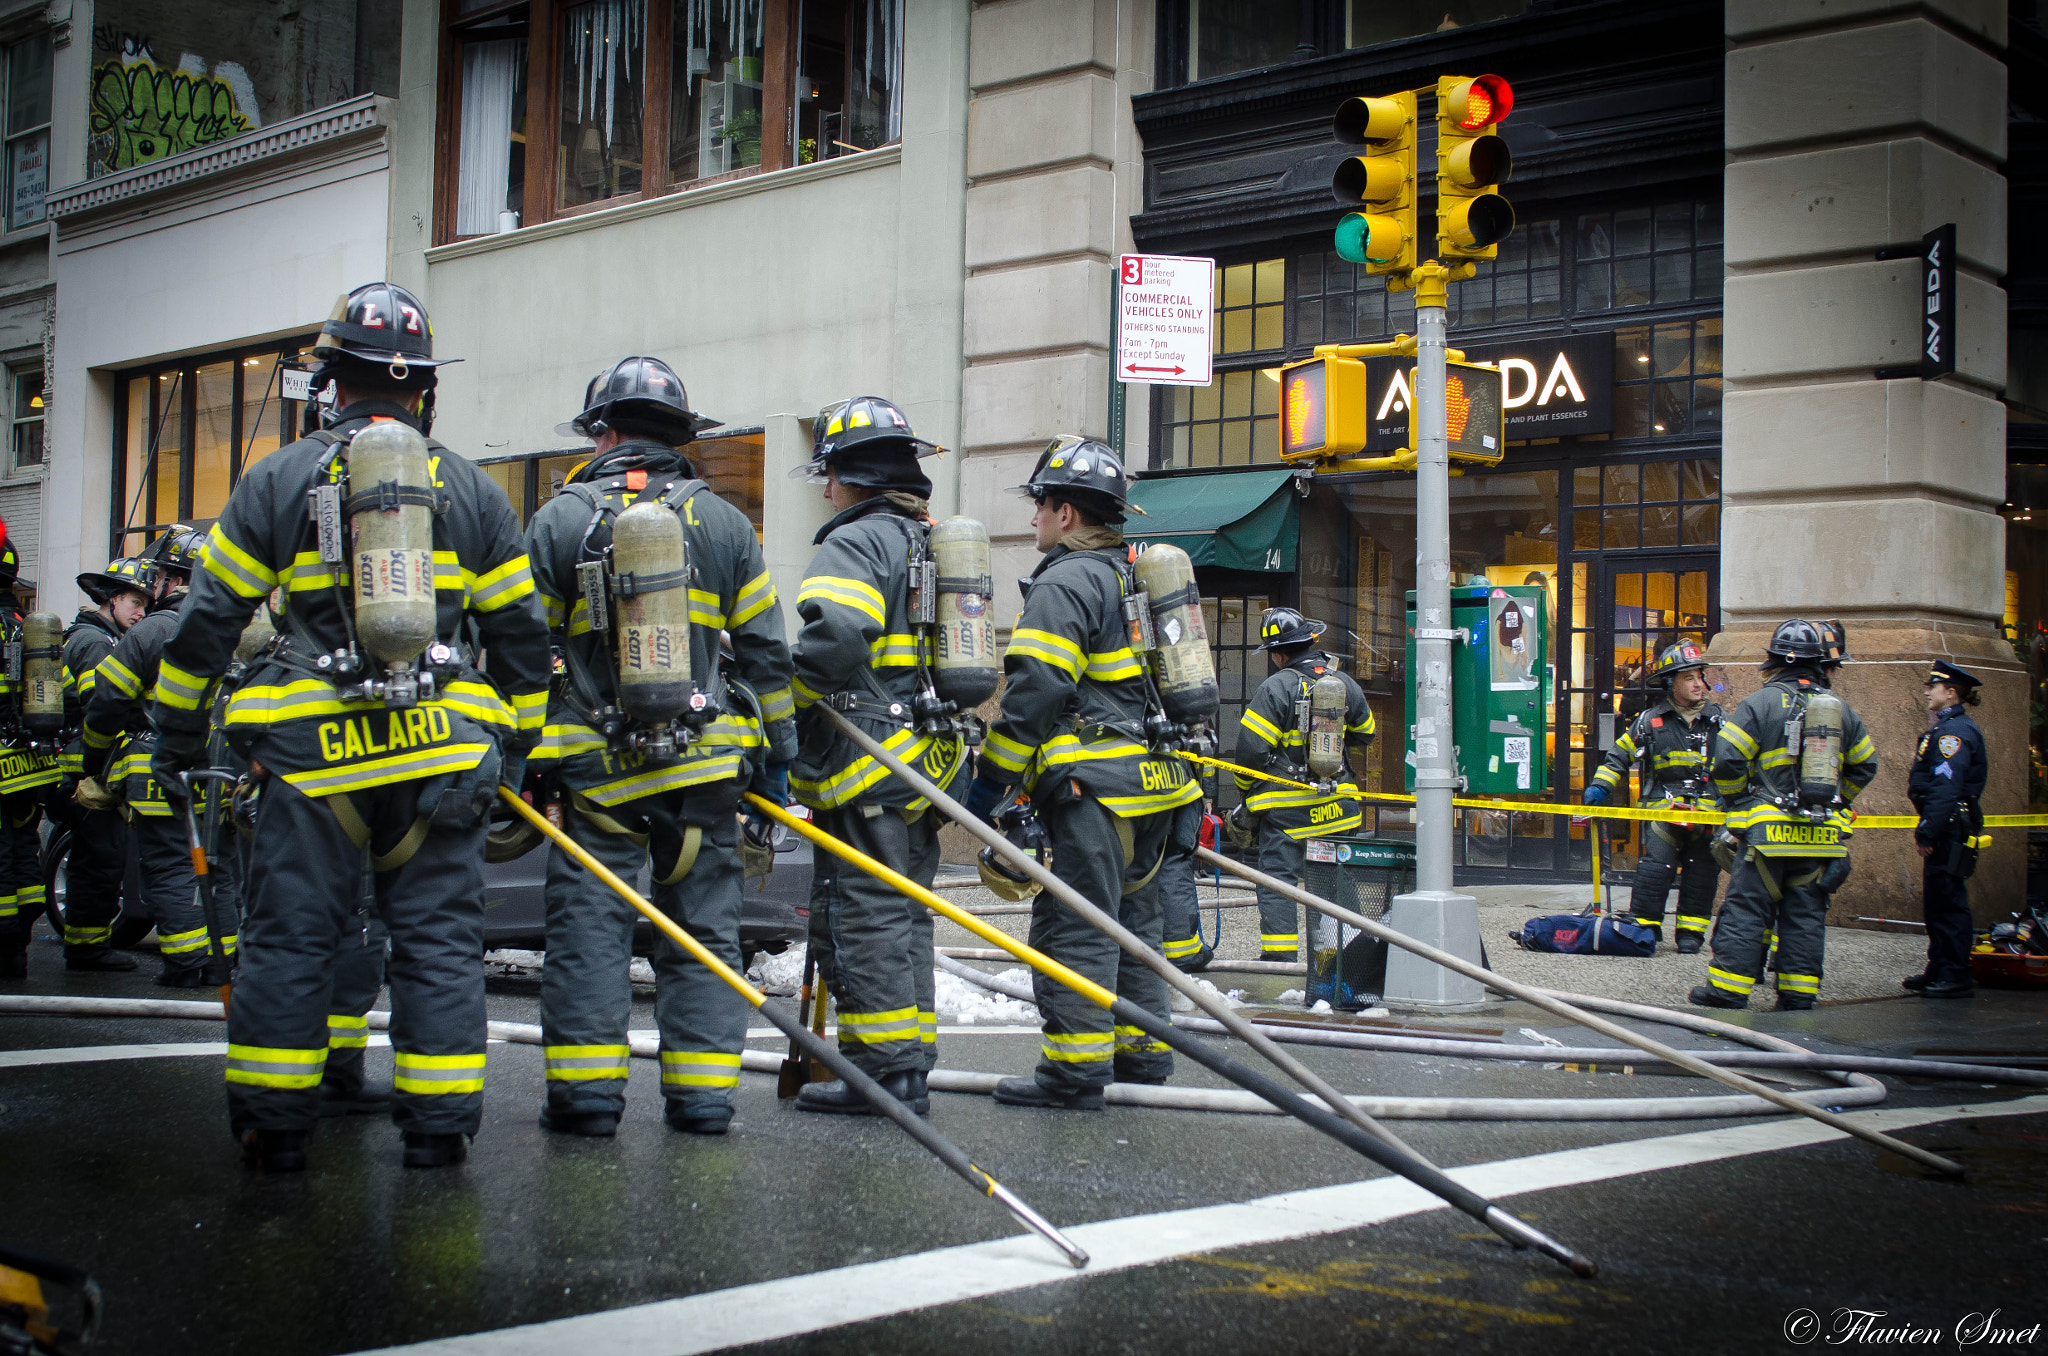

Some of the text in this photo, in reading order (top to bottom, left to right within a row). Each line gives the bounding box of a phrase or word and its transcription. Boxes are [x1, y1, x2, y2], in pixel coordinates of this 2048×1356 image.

[1124, 259, 1140, 284] 3
[1144, 260, 1161, 268] hour
[1144, 269, 1175, 278] metered
[1144, 277, 1171, 286] parking
[1125, 292, 1193, 306] COMMERCIAL
[1927, 239, 1941, 363] AVEDA
[362, 303, 420, 334] L 7
[1125, 306, 1203, 319] VEHICLES ONLY
[1124, 322, 1205, 334] OTHERS NO STANDING
[1124, 337, 1142, 347] 7am
[1150, 339, 1168, 349] 7pm
[1123, 349, 1186, 362] Except Sunday
[1375, 351, 1586, 421] ADA
[1510, 416, 1525, 424] AND
[1526, 414, 1549, 422] PLANT
[1551, 410, 1588, 420] ESSENCES
[1378, 426, 1405, 436] THE ART
[1264, 548, 1281, 570] 140
[361, 553, 375, 601] SCOTT
[390, 549, 408, 598] SCOTT
[628, 628, 642, 670] SCOTT
[656, 626, 671, 669] SCOTT
[960, 620, 974, 658] SCOTT
[984, 620, 994, 658] SCOTT
[318, 706, 452, 762] GALARD
[1323, 733, 1331, 754] SCOTT
[0, 752, 57, 780] DONAHU
[1310, 802, 1343, 824] SIMON
[1355, 850, 1370, 858] Keep
